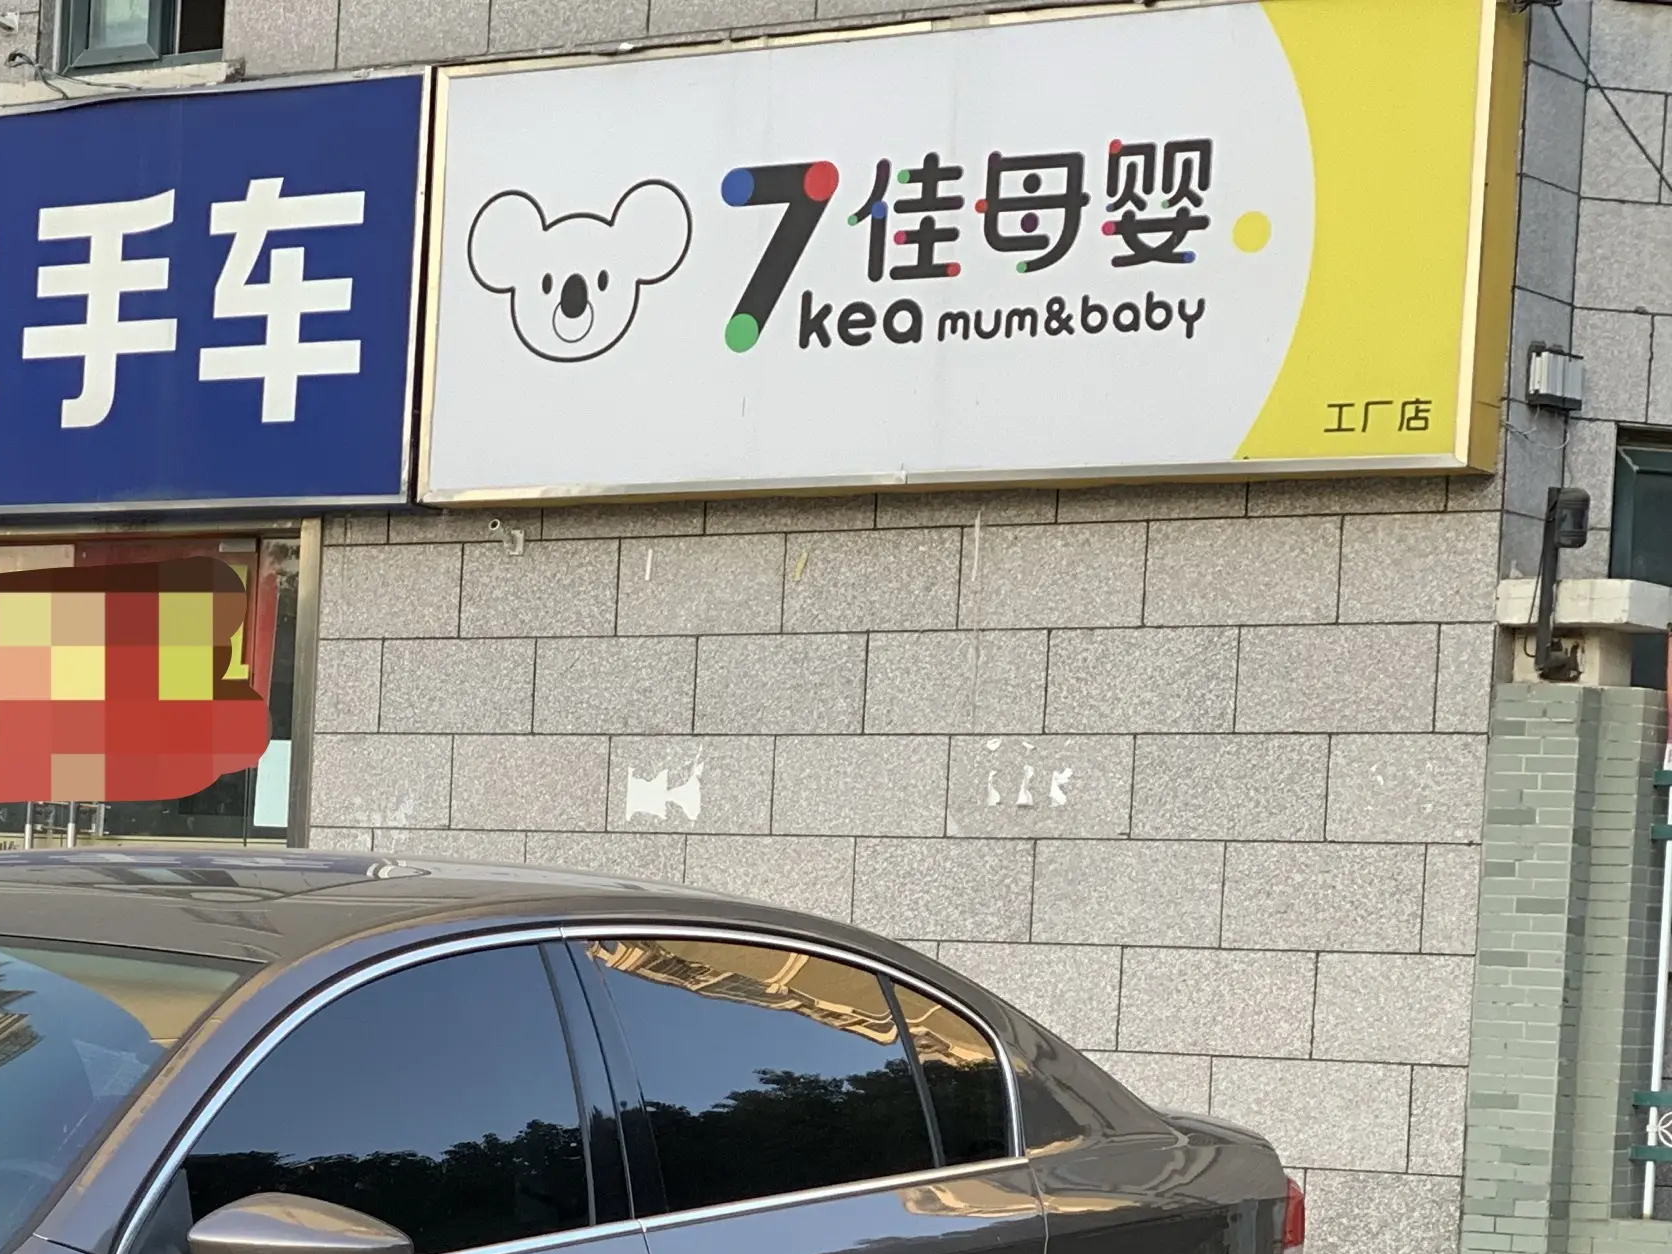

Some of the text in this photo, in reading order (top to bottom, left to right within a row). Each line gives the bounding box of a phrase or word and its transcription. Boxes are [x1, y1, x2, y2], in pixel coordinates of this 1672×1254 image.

[798, 289, 1207, 350] kea mum&baby
[1323, 397, 1433, 433] 工厂店
